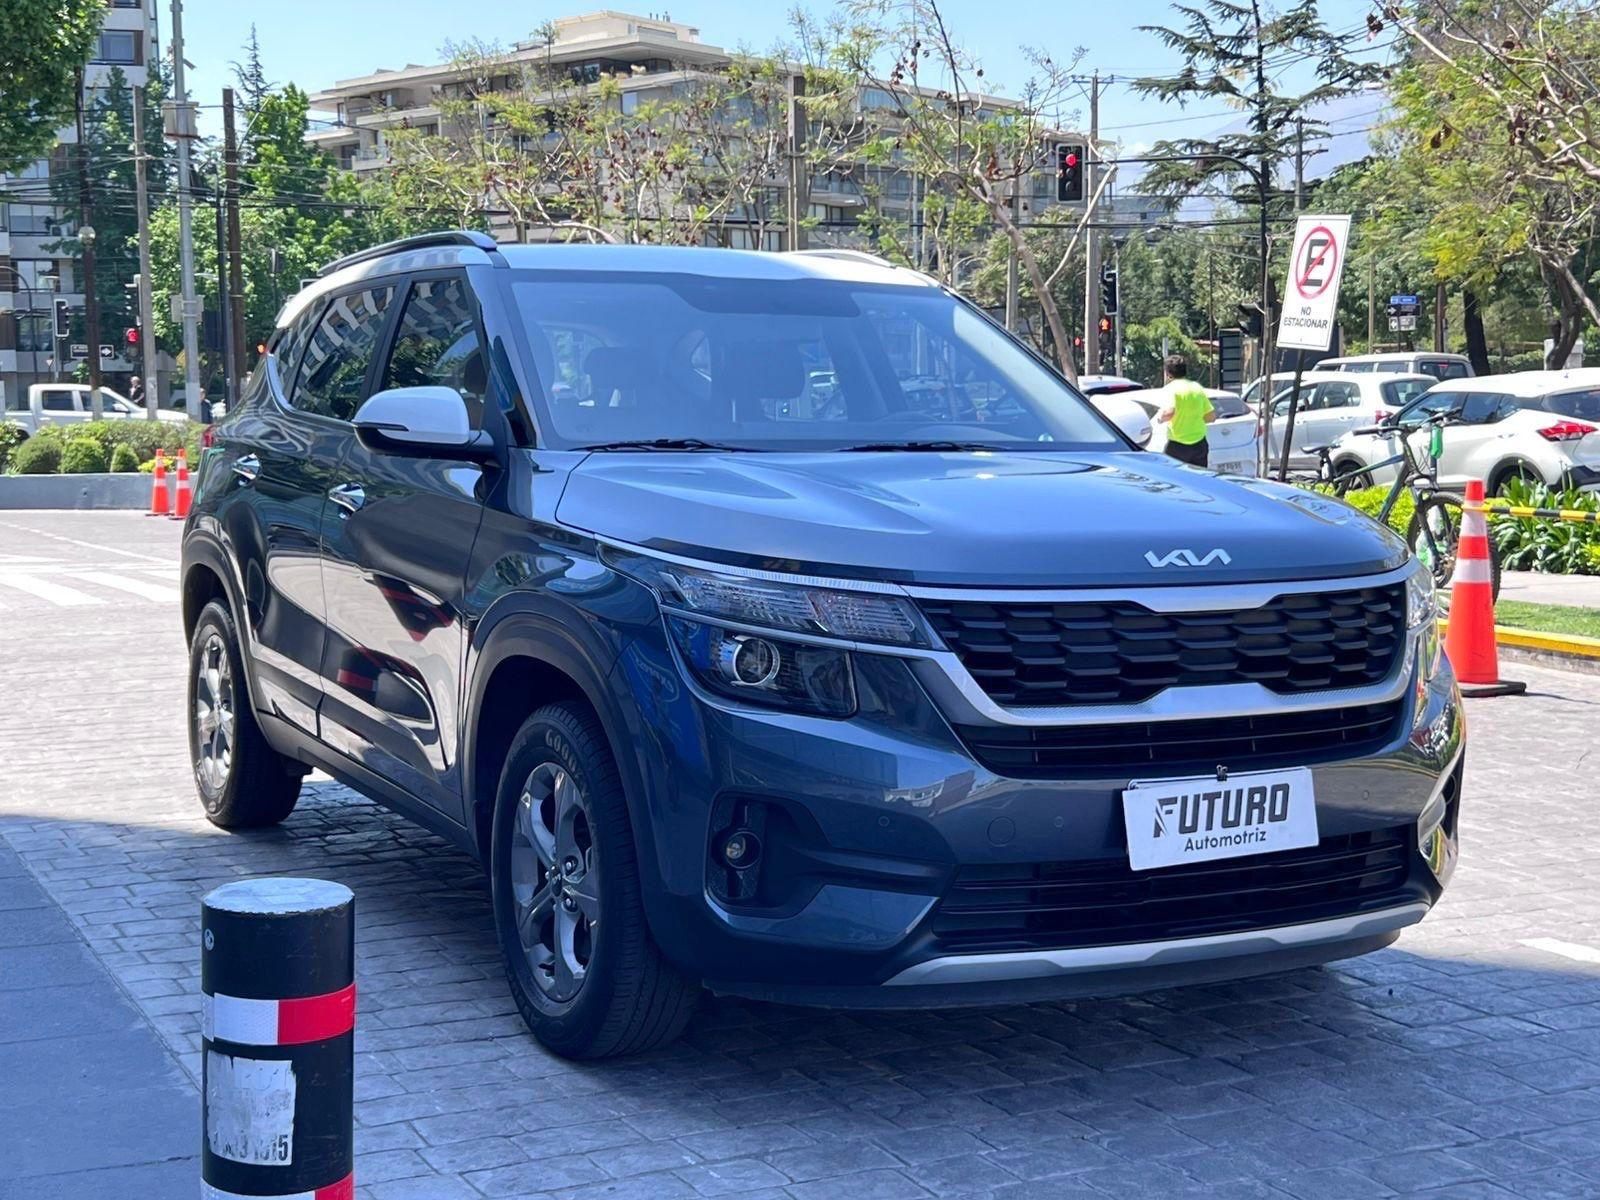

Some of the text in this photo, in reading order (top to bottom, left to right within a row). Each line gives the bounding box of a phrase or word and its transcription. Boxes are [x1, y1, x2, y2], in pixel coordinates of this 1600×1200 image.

[1300, 306, 1312, 316] NO
[1283, 318, 1329, 329] ESTACIONAR
[1144, 548, 1232, 568] KIA
[1153, 783, 1289, 838] FUTURO
[1184, 828, 1267, 852] Automotriz
